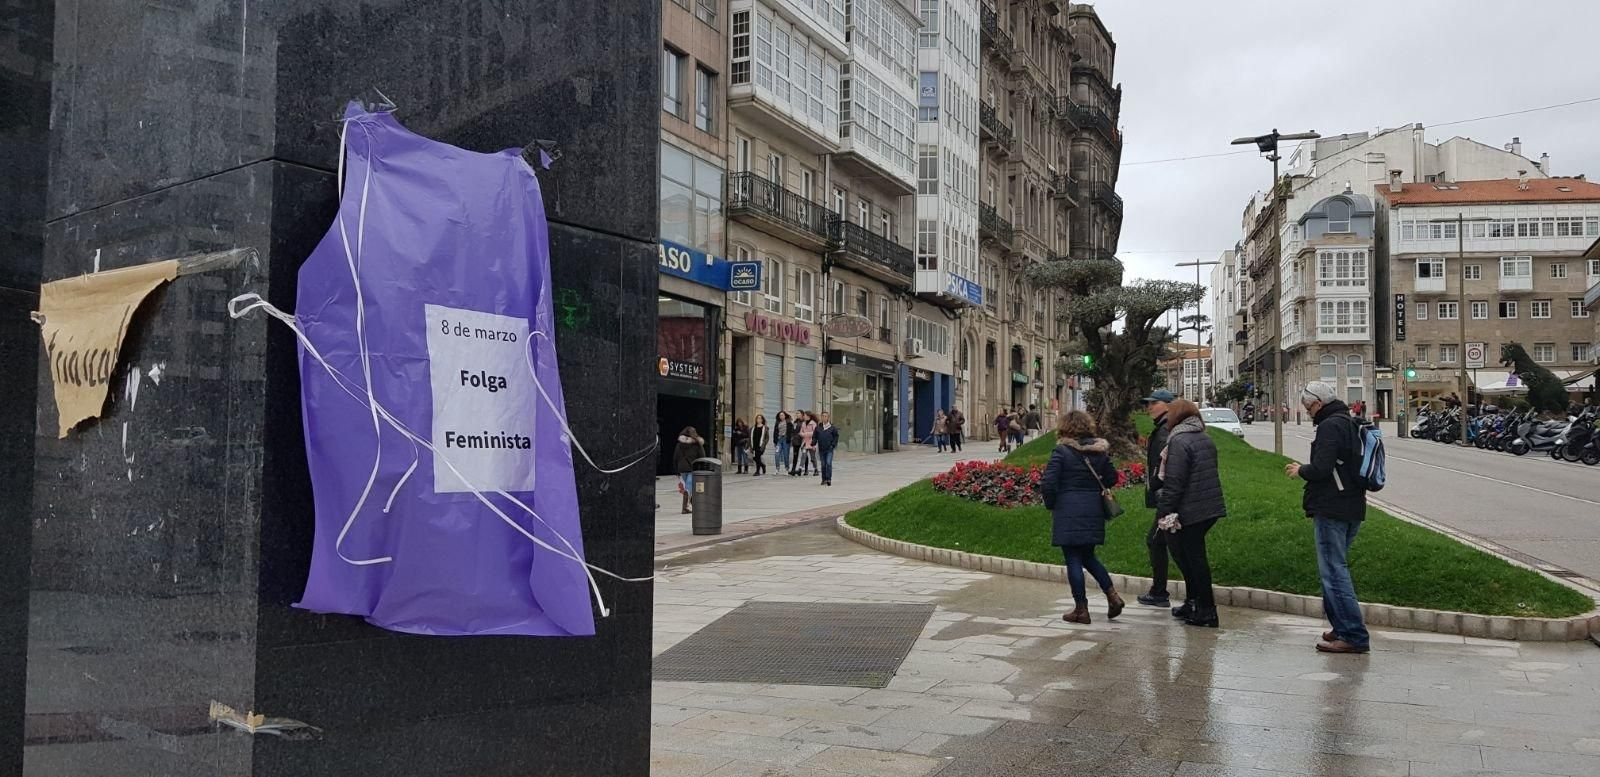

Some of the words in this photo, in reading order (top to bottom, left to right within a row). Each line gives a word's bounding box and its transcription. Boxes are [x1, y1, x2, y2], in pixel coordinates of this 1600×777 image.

[441, 319, 449, 335] 8
[454, 322, 470, 338] de
[475, 328, 517, 343] marzo
[460, 370, 507, 393] Folga
[445, 431, 531, 450] Feminista
